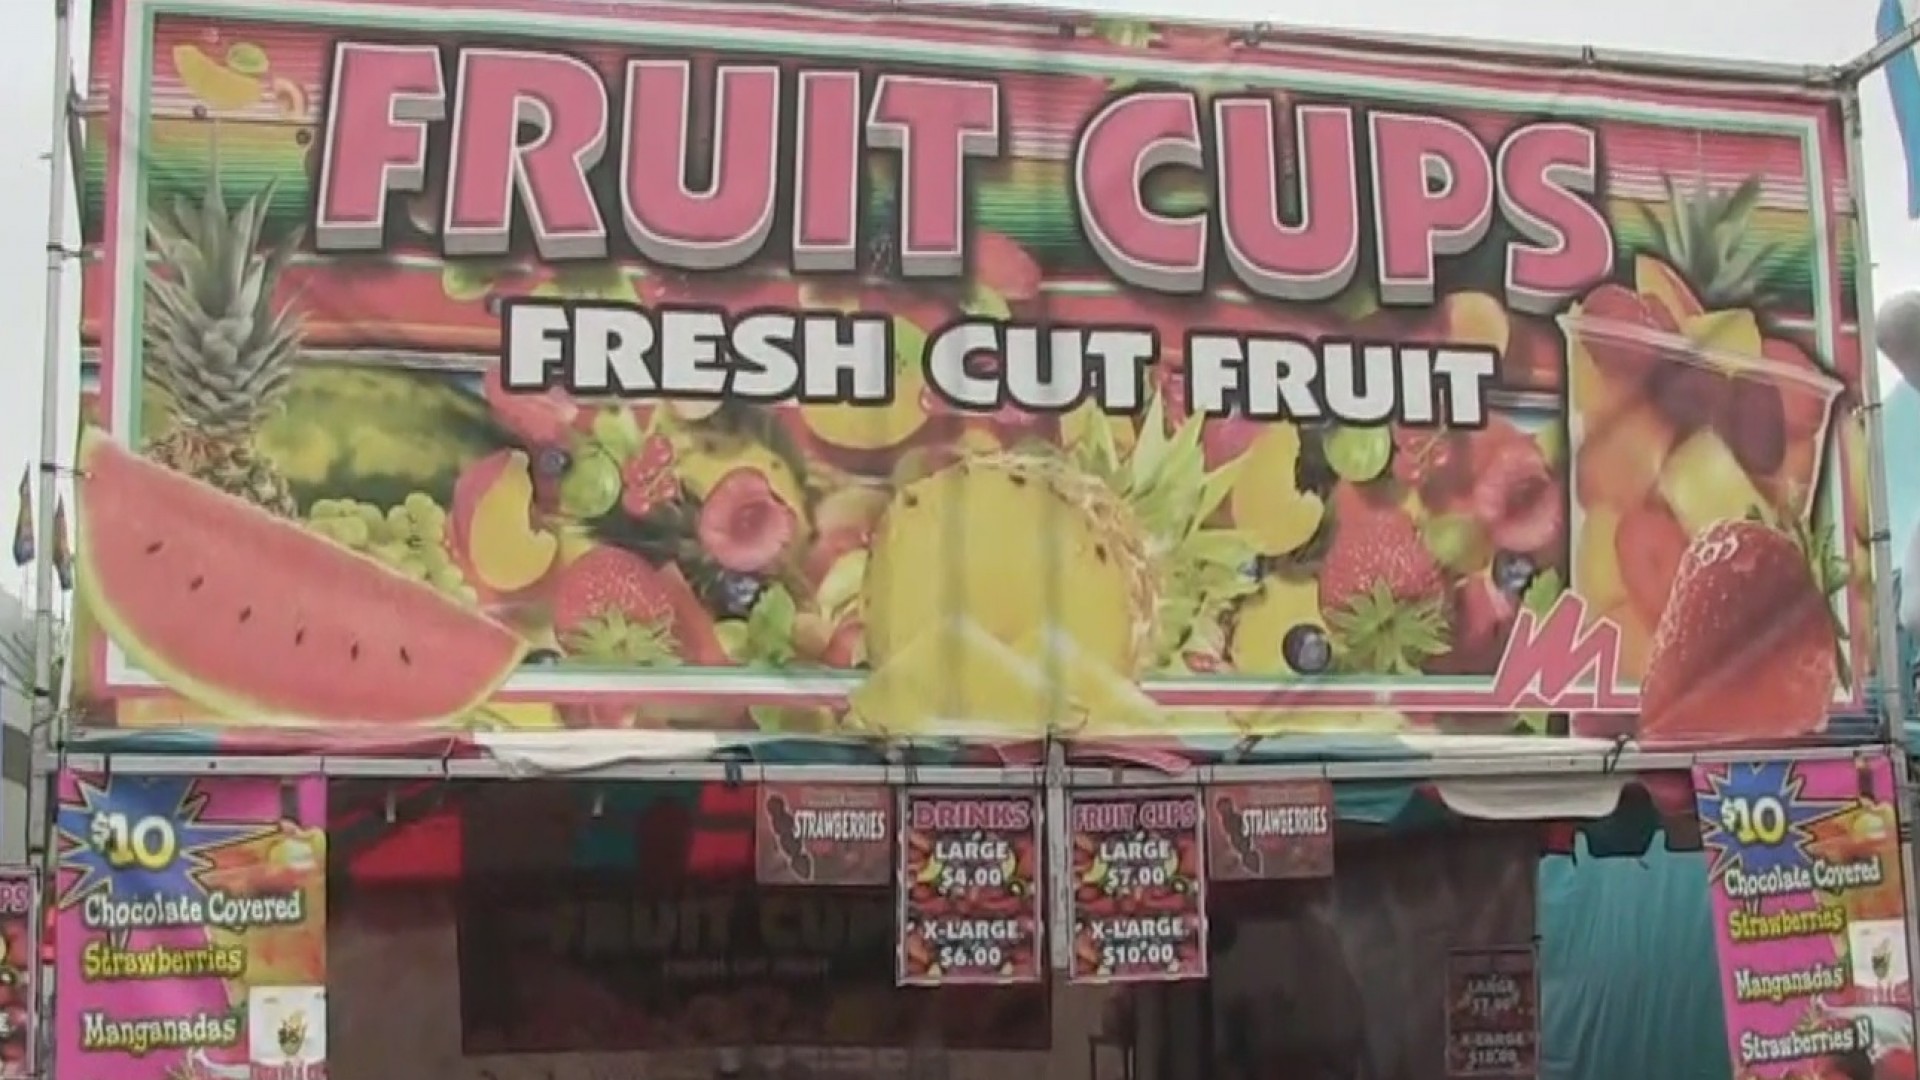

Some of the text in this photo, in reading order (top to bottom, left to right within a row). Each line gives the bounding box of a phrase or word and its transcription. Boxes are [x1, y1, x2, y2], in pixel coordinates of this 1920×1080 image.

[316, 41, 1614, 313] FRUIT CUPS
[509, 305, 1495, 425] FRESH CUT FRUIT
[793, 810, 886, 840] STRAWBERRIES
[913, 800, 1030, 829] DRINKS
[1074, 801, 1196, 831] FRUIT CUPS
[1241, 807, 1328, 837] STRAWBERRIES
[1721, 797, 1787, 845] $10
[91, 813, 177, 869] $10
[935, 841, 1007, 861] LARGE
[1101, 840, 1173, 861] LARGE
[941, 867, 1002, 888] $4.00
[1106, 866, 1166, 887] $7.00
[1725, 857, 1881, 895] Chocolate Covered
[84, 891, 301, 924] Chocolate Covered
[923, 920, 1018, 939] X-LARGE
[1091, 920, 1184, 939] X-LARGE
[1728, 909, 1845, 938] Strawberries
[84, 945, 243, 974] Strawberries
[940, 946, 1001, 967] $6.00
[1103, 945, 1174, 964] $10.00
[1735, 966, 1844, 1000] Manganadas
[84, 1012, 237, 1049] Manganadas
[1741, 1019, 1873, 1061] Strawberries N
